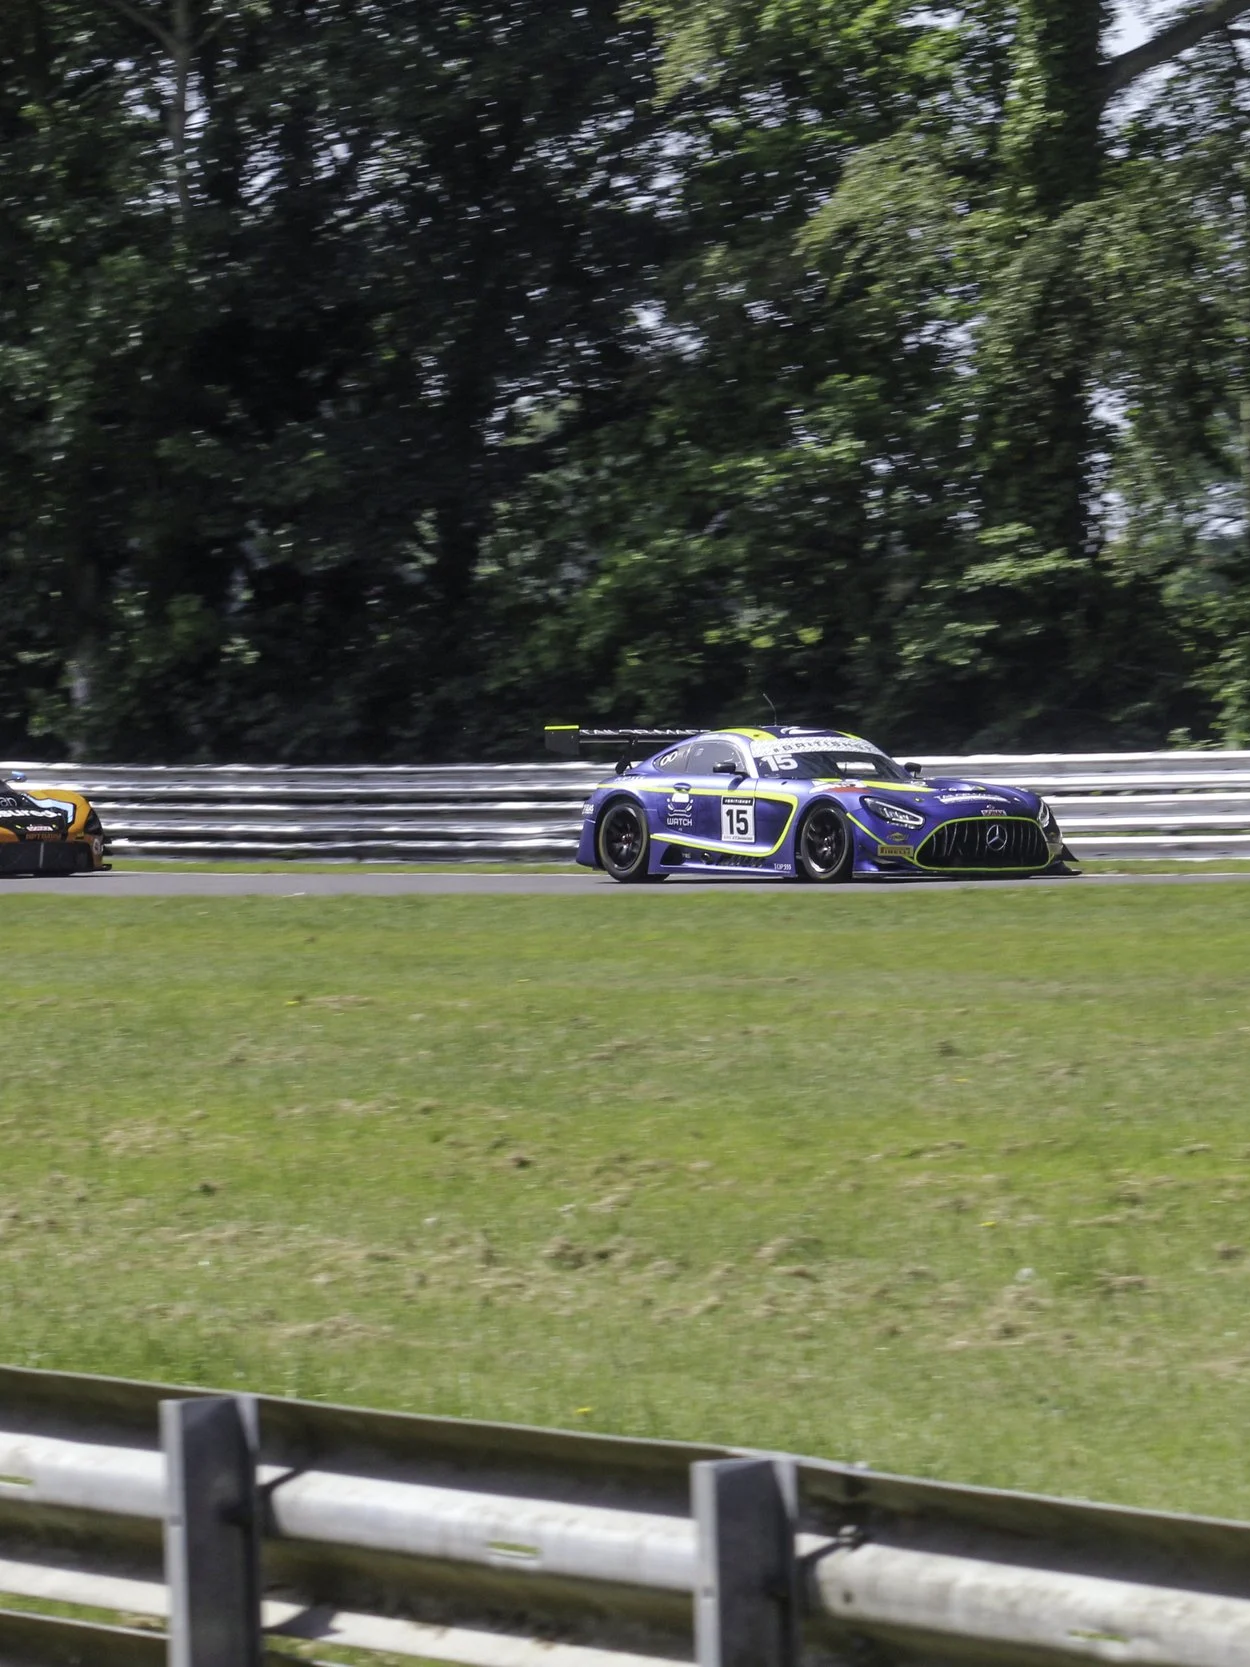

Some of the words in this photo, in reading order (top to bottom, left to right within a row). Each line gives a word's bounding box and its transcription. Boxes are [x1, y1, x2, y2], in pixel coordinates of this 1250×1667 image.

[760, 754, 798, 771] 15
[667, 818, 693, 826] WATCH
[726, 809, 749, 835] 15
